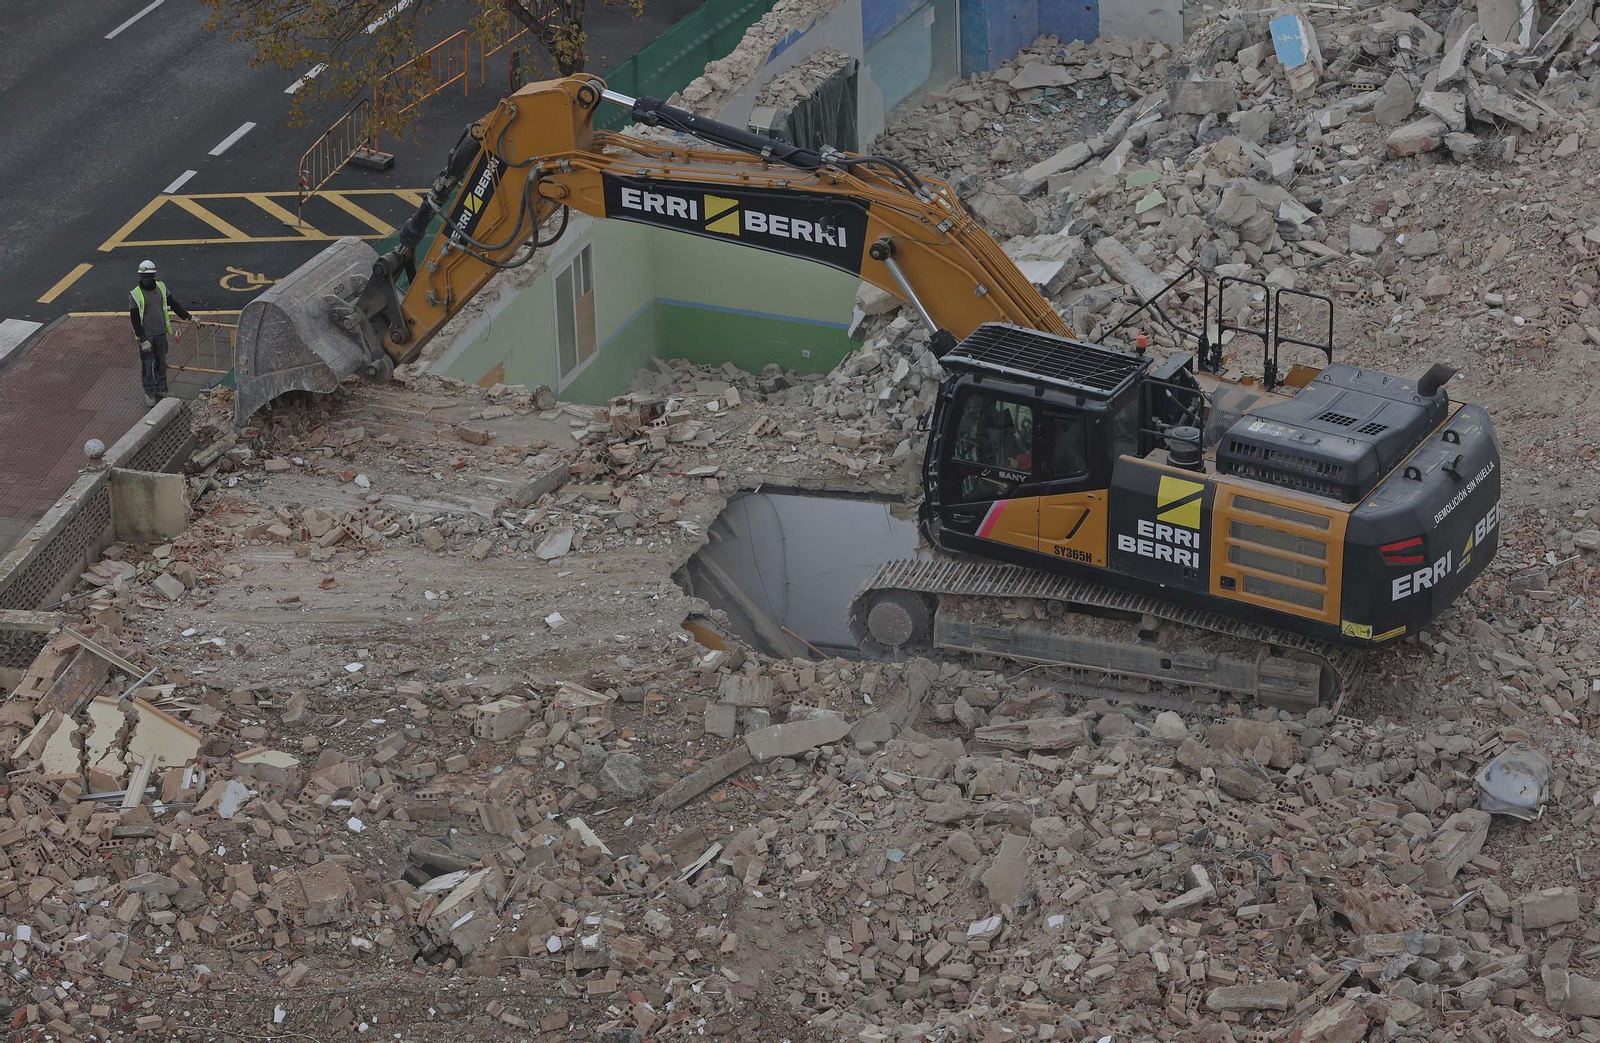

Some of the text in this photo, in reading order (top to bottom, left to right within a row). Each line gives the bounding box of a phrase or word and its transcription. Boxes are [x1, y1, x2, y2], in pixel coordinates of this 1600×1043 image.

[621, 187, 847, 248] ERRI BERRI
[998, 471, 1026, 482] SANY
[1466, 480, 1477, 493] SIN
[1474, 460, 1495, 484] HUELLA
[1137, 518, 1200, 549] ERRI
[1054, 544, 1092, 563] SY365H
[1117, 533, 1200, 569] BERRI
[1392, 549, 1452, 602] ERRI
